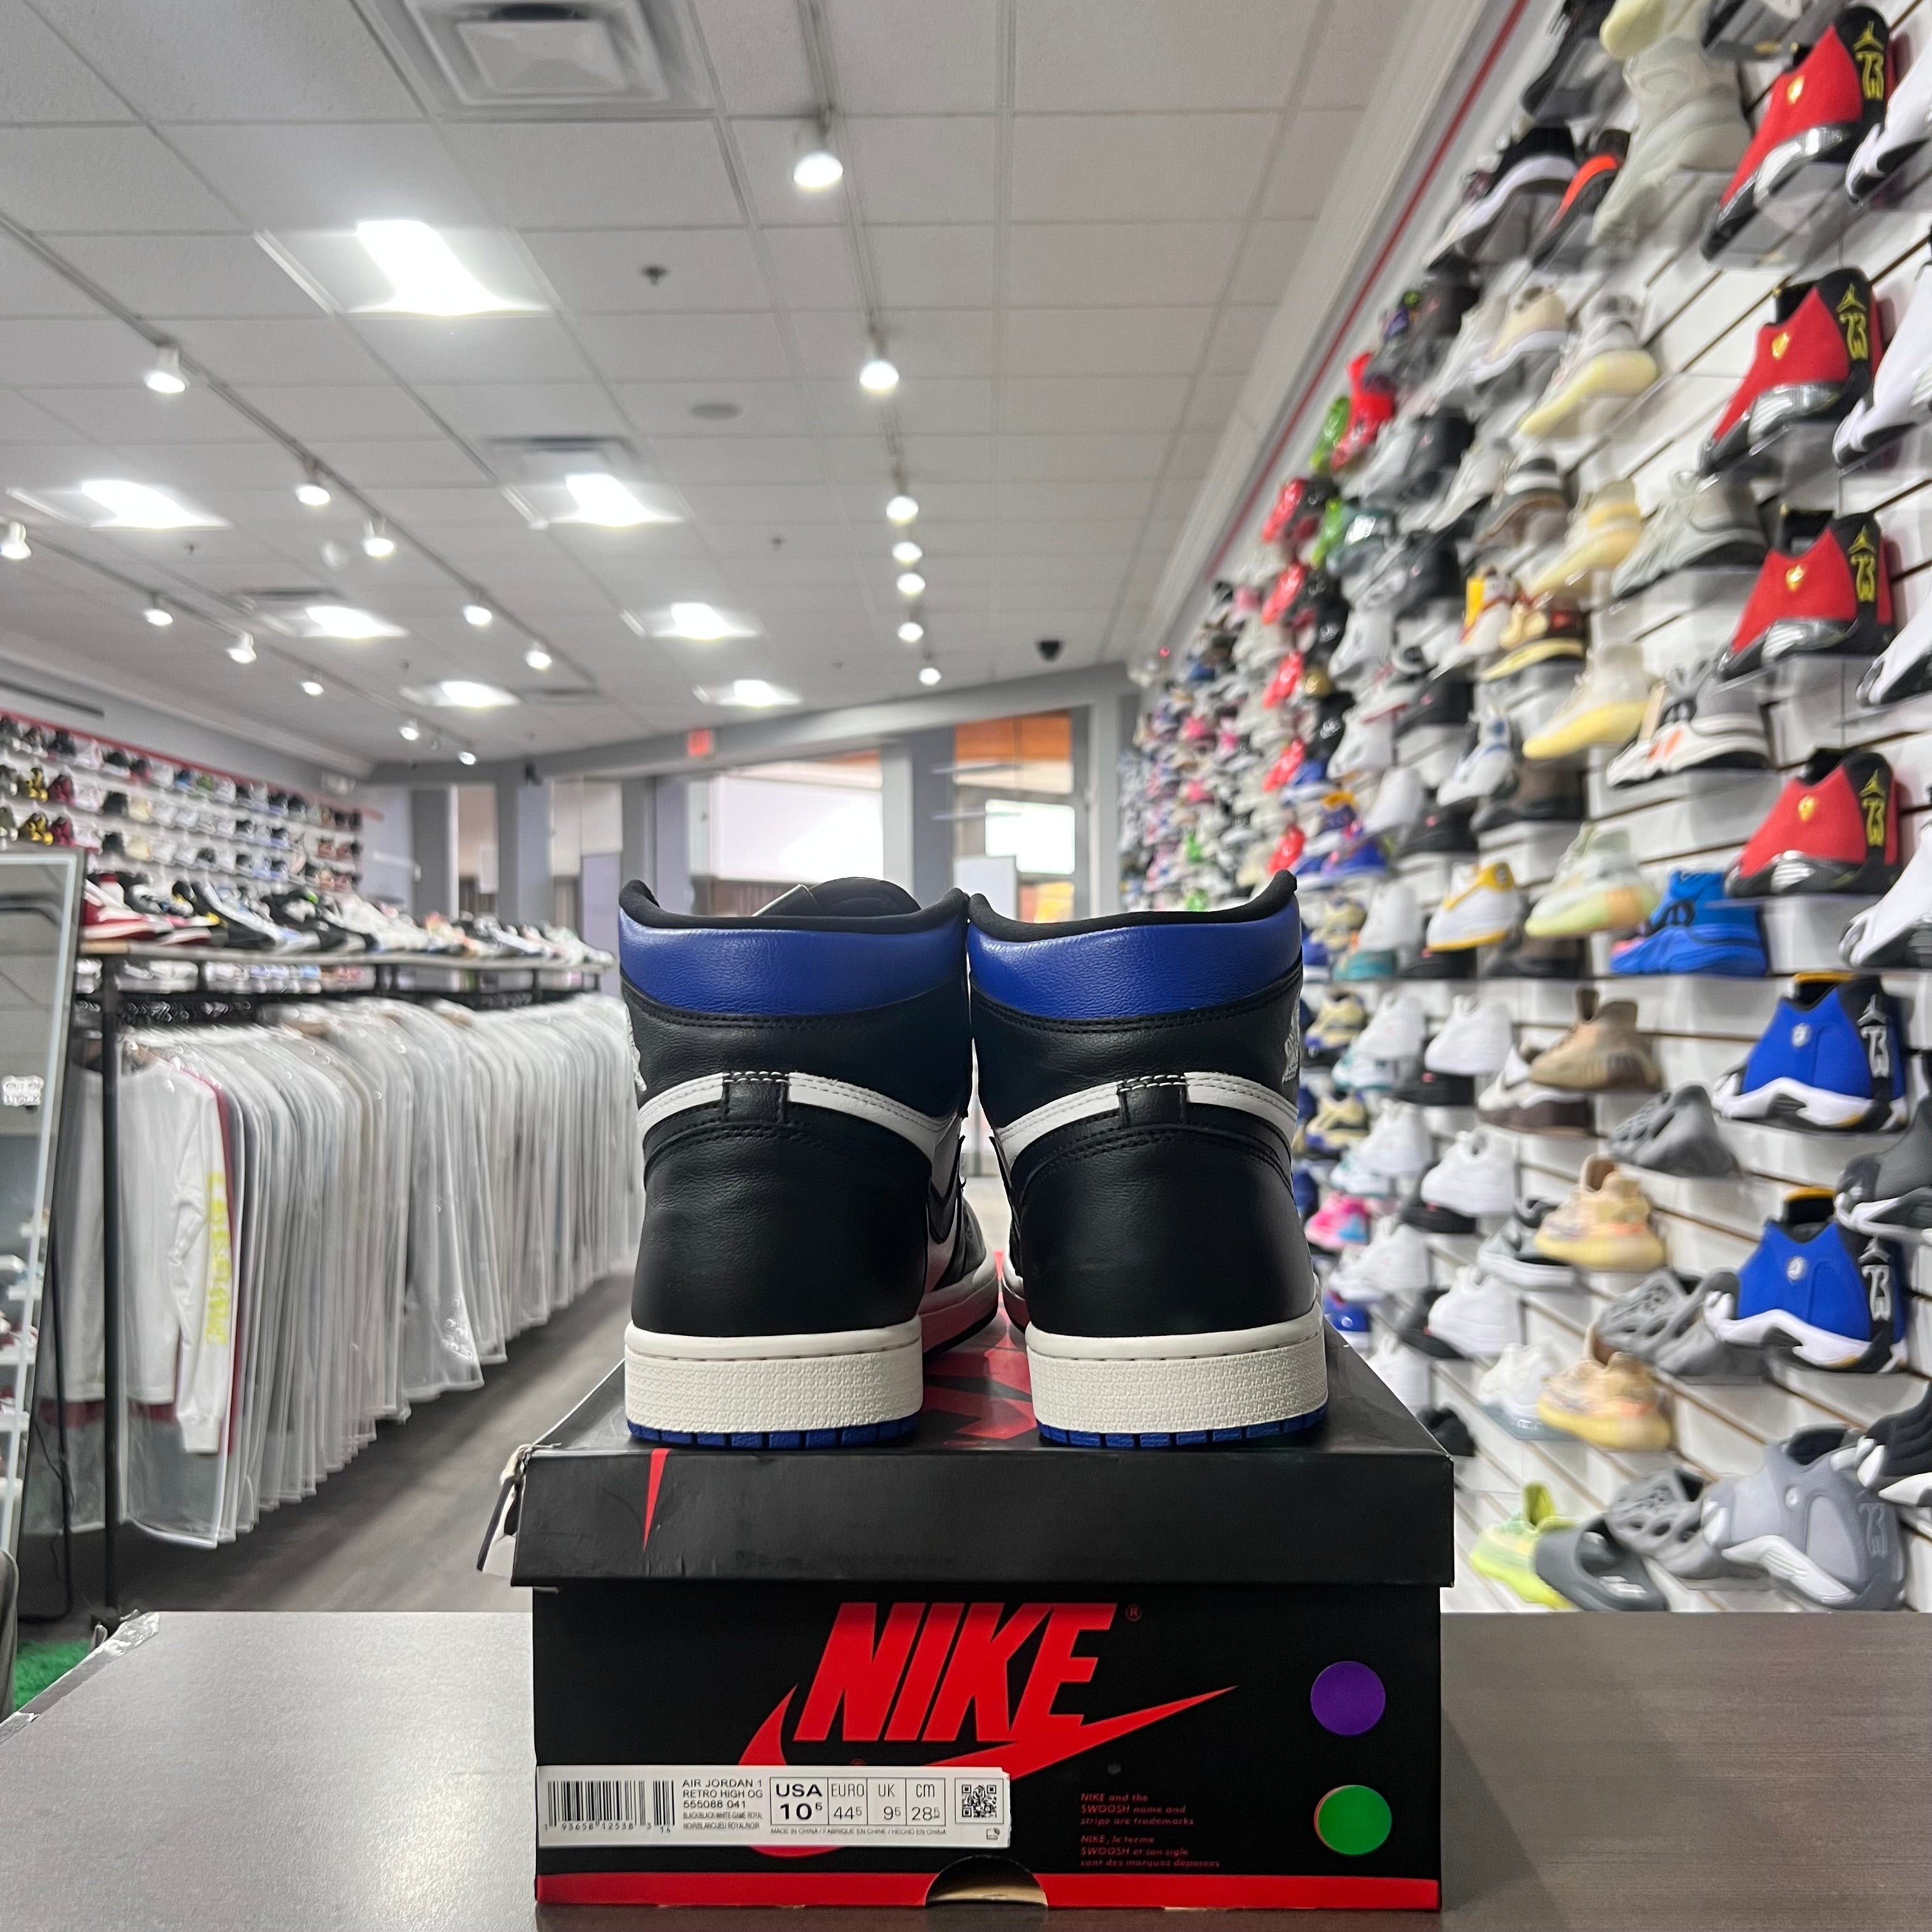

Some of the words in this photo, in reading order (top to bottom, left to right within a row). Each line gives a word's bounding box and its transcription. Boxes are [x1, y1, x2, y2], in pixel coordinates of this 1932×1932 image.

[793, 1602, 1118, 1742] NIKE
[682, 1779, 701, 1788] AIR
[705, 1779, 753, 1788] JORDAN
[758, 1779, 762, 1787] 1
[683, 1790, 717, 1798] RETRO
[720, 1790, 745, 1798] HIGH
[747, 1790, 763, 1798] OG
[776, 1783, 823, 1797] USA
[831, 1783, 864, 1797] EURO
[878, 1783, 895, 1797] UK
[1081, 1793, 1105, 1802] NIKE
[1108, 1793, 1129, 1802] and
[1132, 1792, 1148, 1801] the
[683, 1800, 723, 1809] 555088
[726, 1800, 746, 1809] 041
[1081, 1804, 1130, 1813] SWOOSH
[1166, 1805, 1186, 1813] and
[562, 1822, 594, 1830] 93658
[602, 1821, 634, 1830] 12538
[1080, 1818, 1110, 1826] stripe
[1081, 1846, 1130, 1855] SWOOSH
